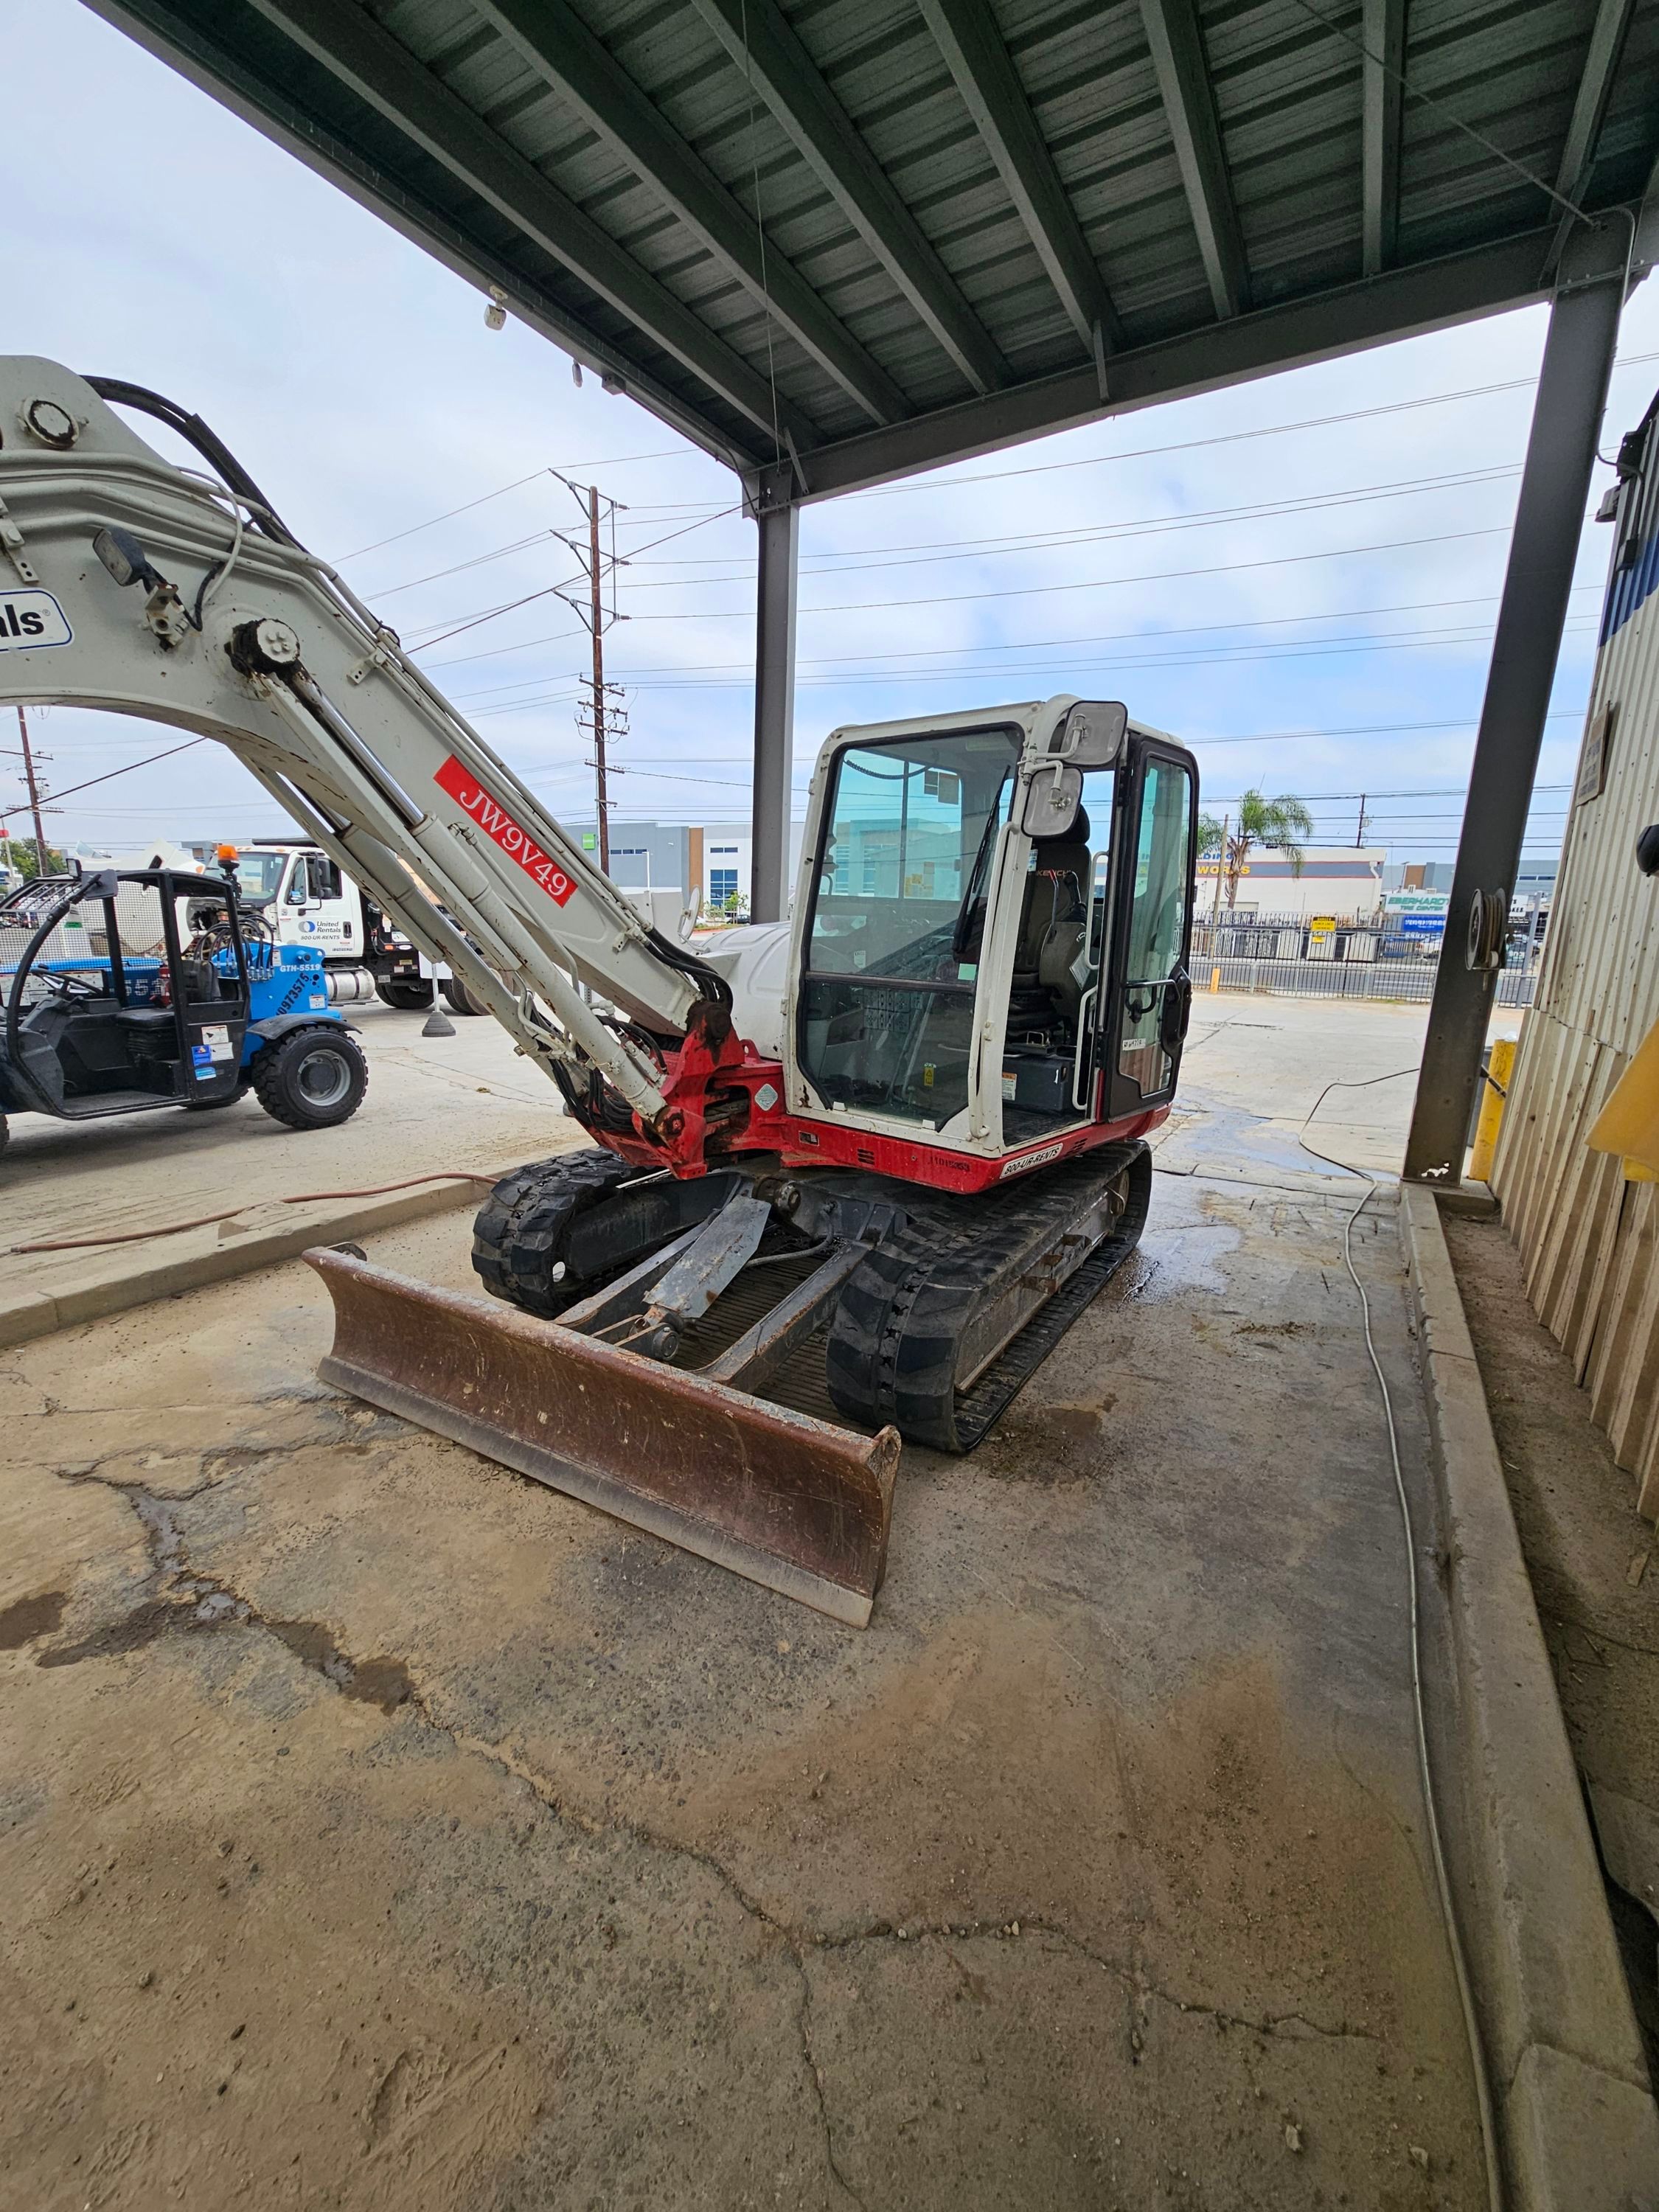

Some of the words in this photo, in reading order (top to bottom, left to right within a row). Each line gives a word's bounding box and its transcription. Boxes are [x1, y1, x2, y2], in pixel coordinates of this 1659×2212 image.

[459, 789, 568, 897] JW9V49
[1197, 866, 1251, 874] WORS
[280, 964, 320, 973] GTH-5519
[1004, 1147, 1060, 1175] 800-UR-RENTS
